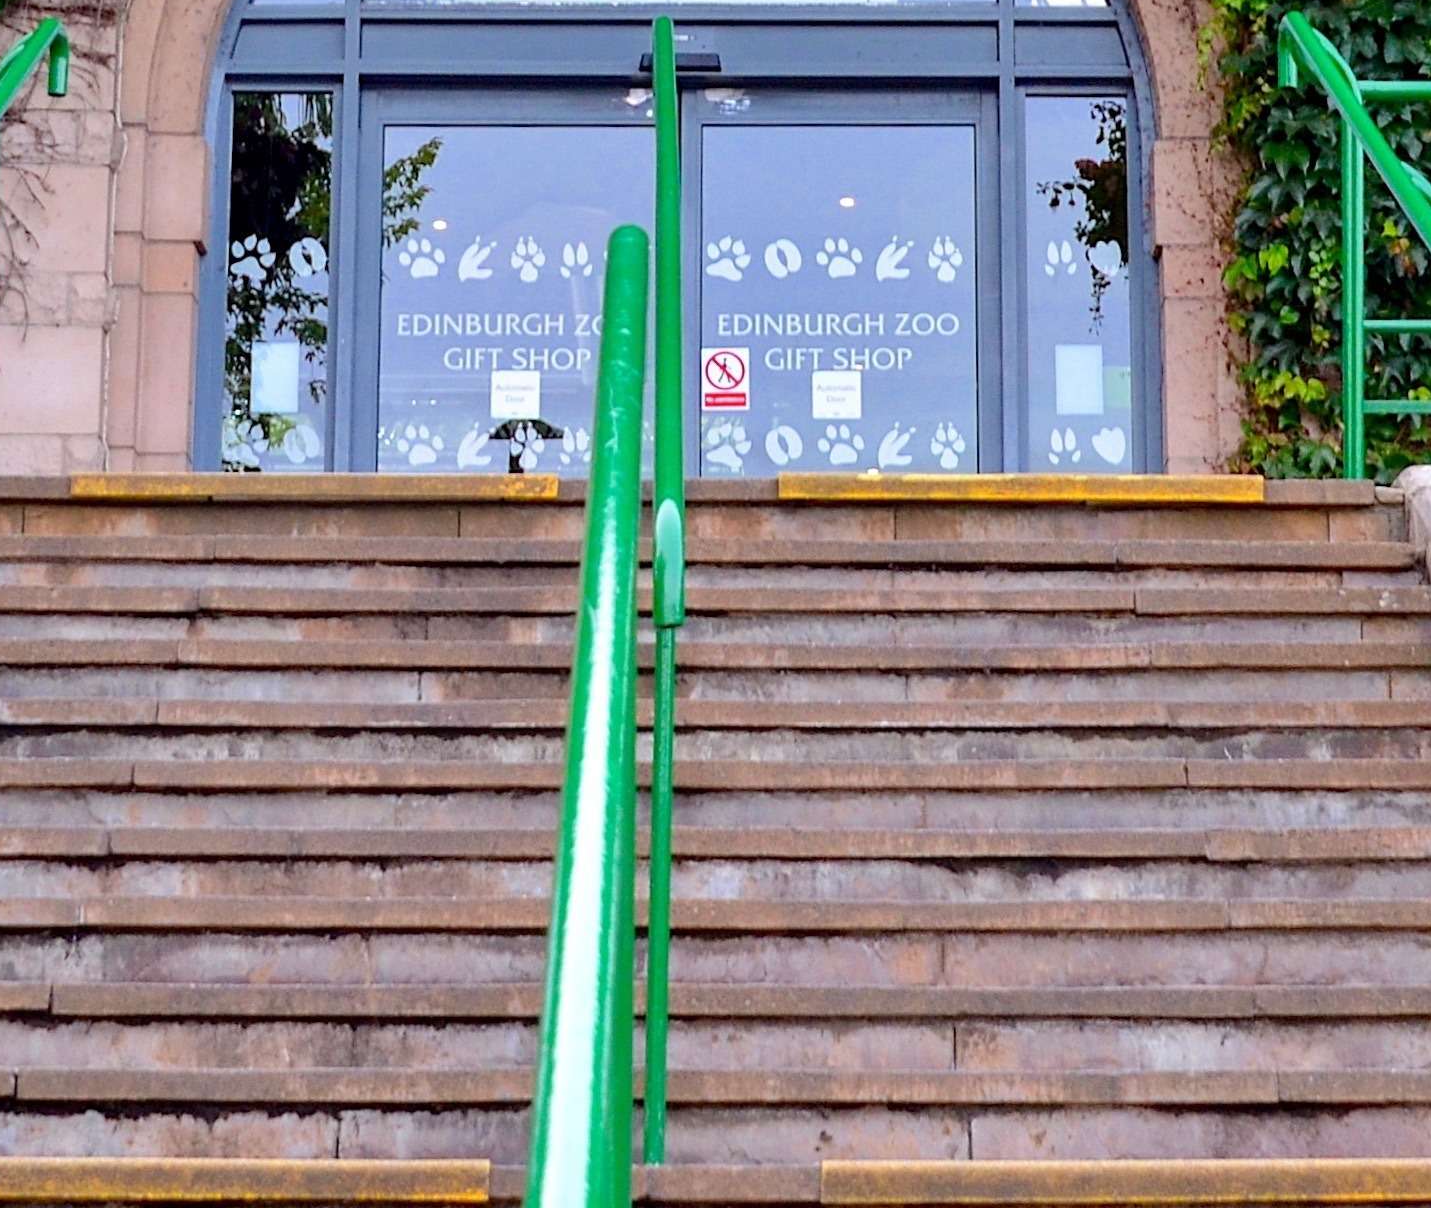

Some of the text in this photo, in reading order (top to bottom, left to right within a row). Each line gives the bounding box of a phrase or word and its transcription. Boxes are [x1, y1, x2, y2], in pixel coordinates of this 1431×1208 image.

[397, 313, 564, 336] EDINBURGH
[718, 313, 959, 336] EDINBURGH ZOO
[443, 348, 591, 370] GIFT SHOP
[764, 348, 912, 370] GIFT SHOP
